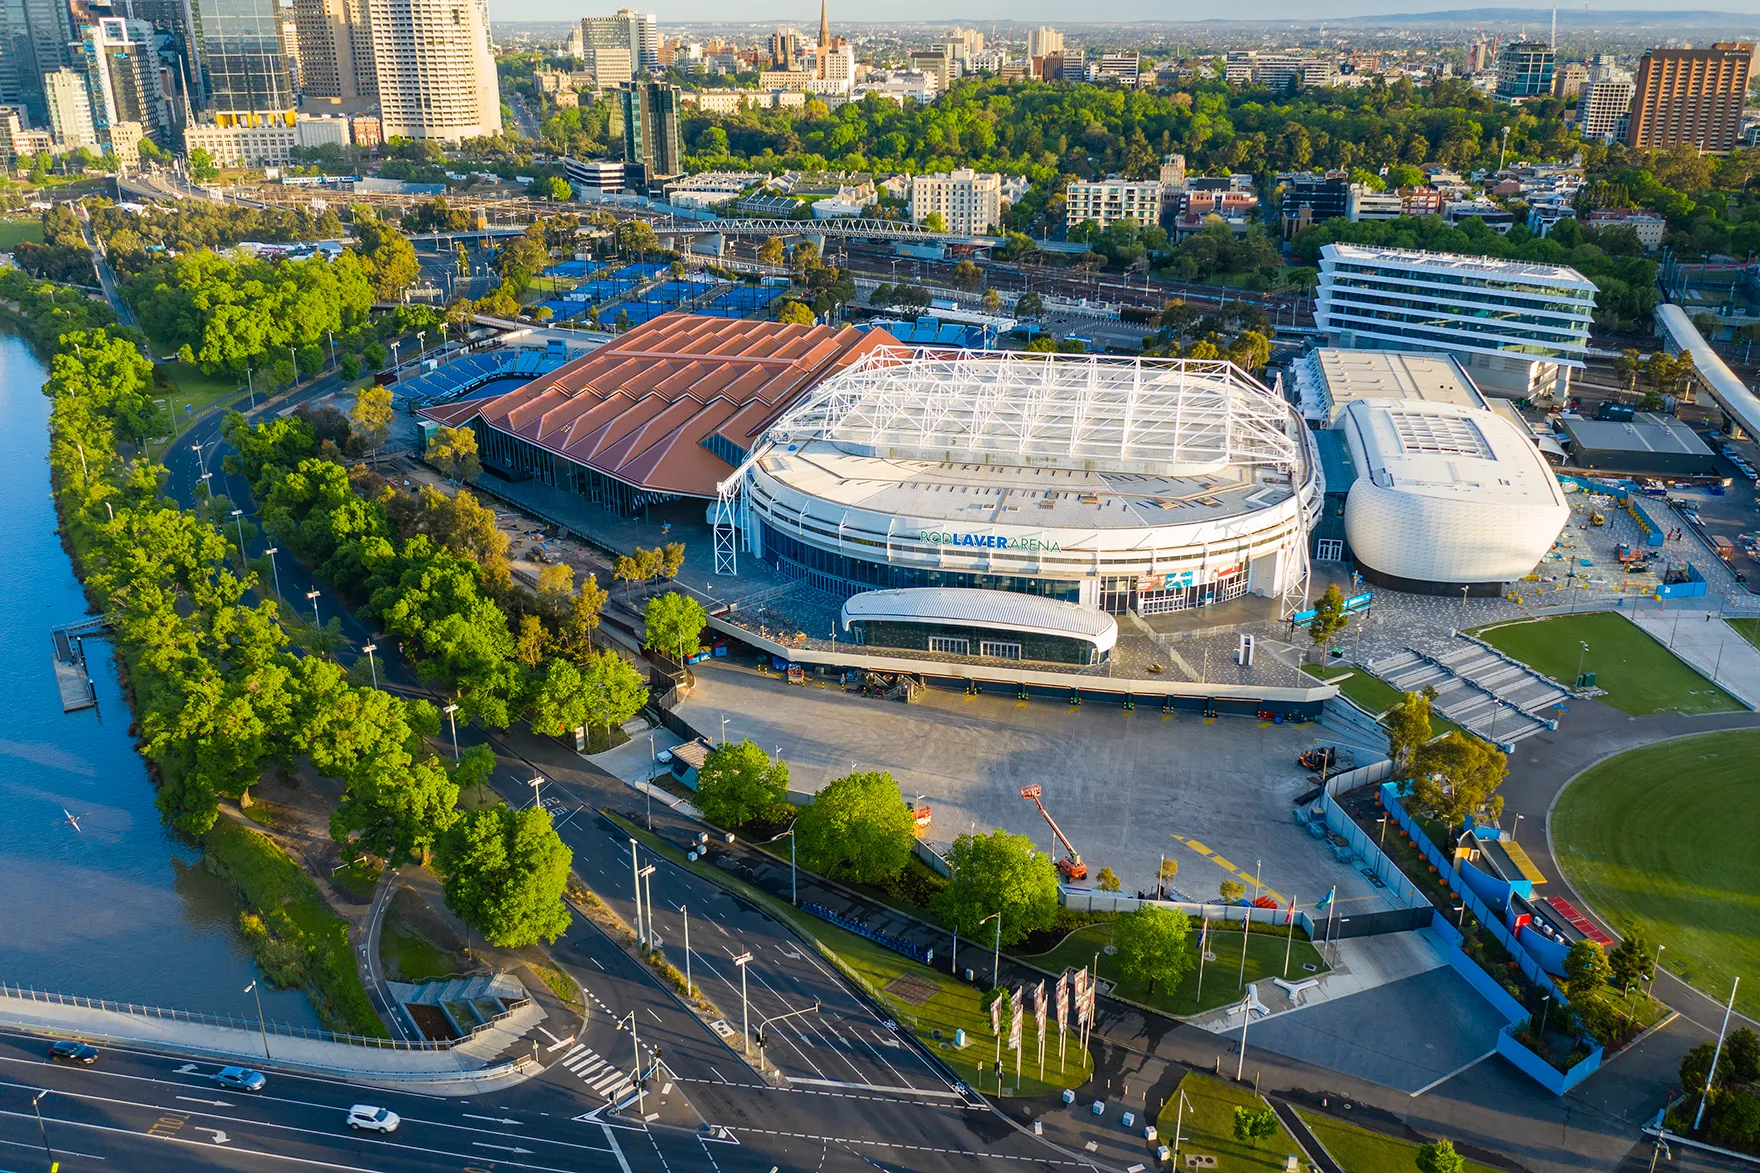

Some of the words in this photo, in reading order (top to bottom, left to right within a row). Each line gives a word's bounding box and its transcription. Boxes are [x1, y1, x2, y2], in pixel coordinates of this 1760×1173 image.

[920, 531, 953, 546] ROD
[953, 533, 1009, 549] LAVER
[1009, 537, 1062, 553] ARENA
